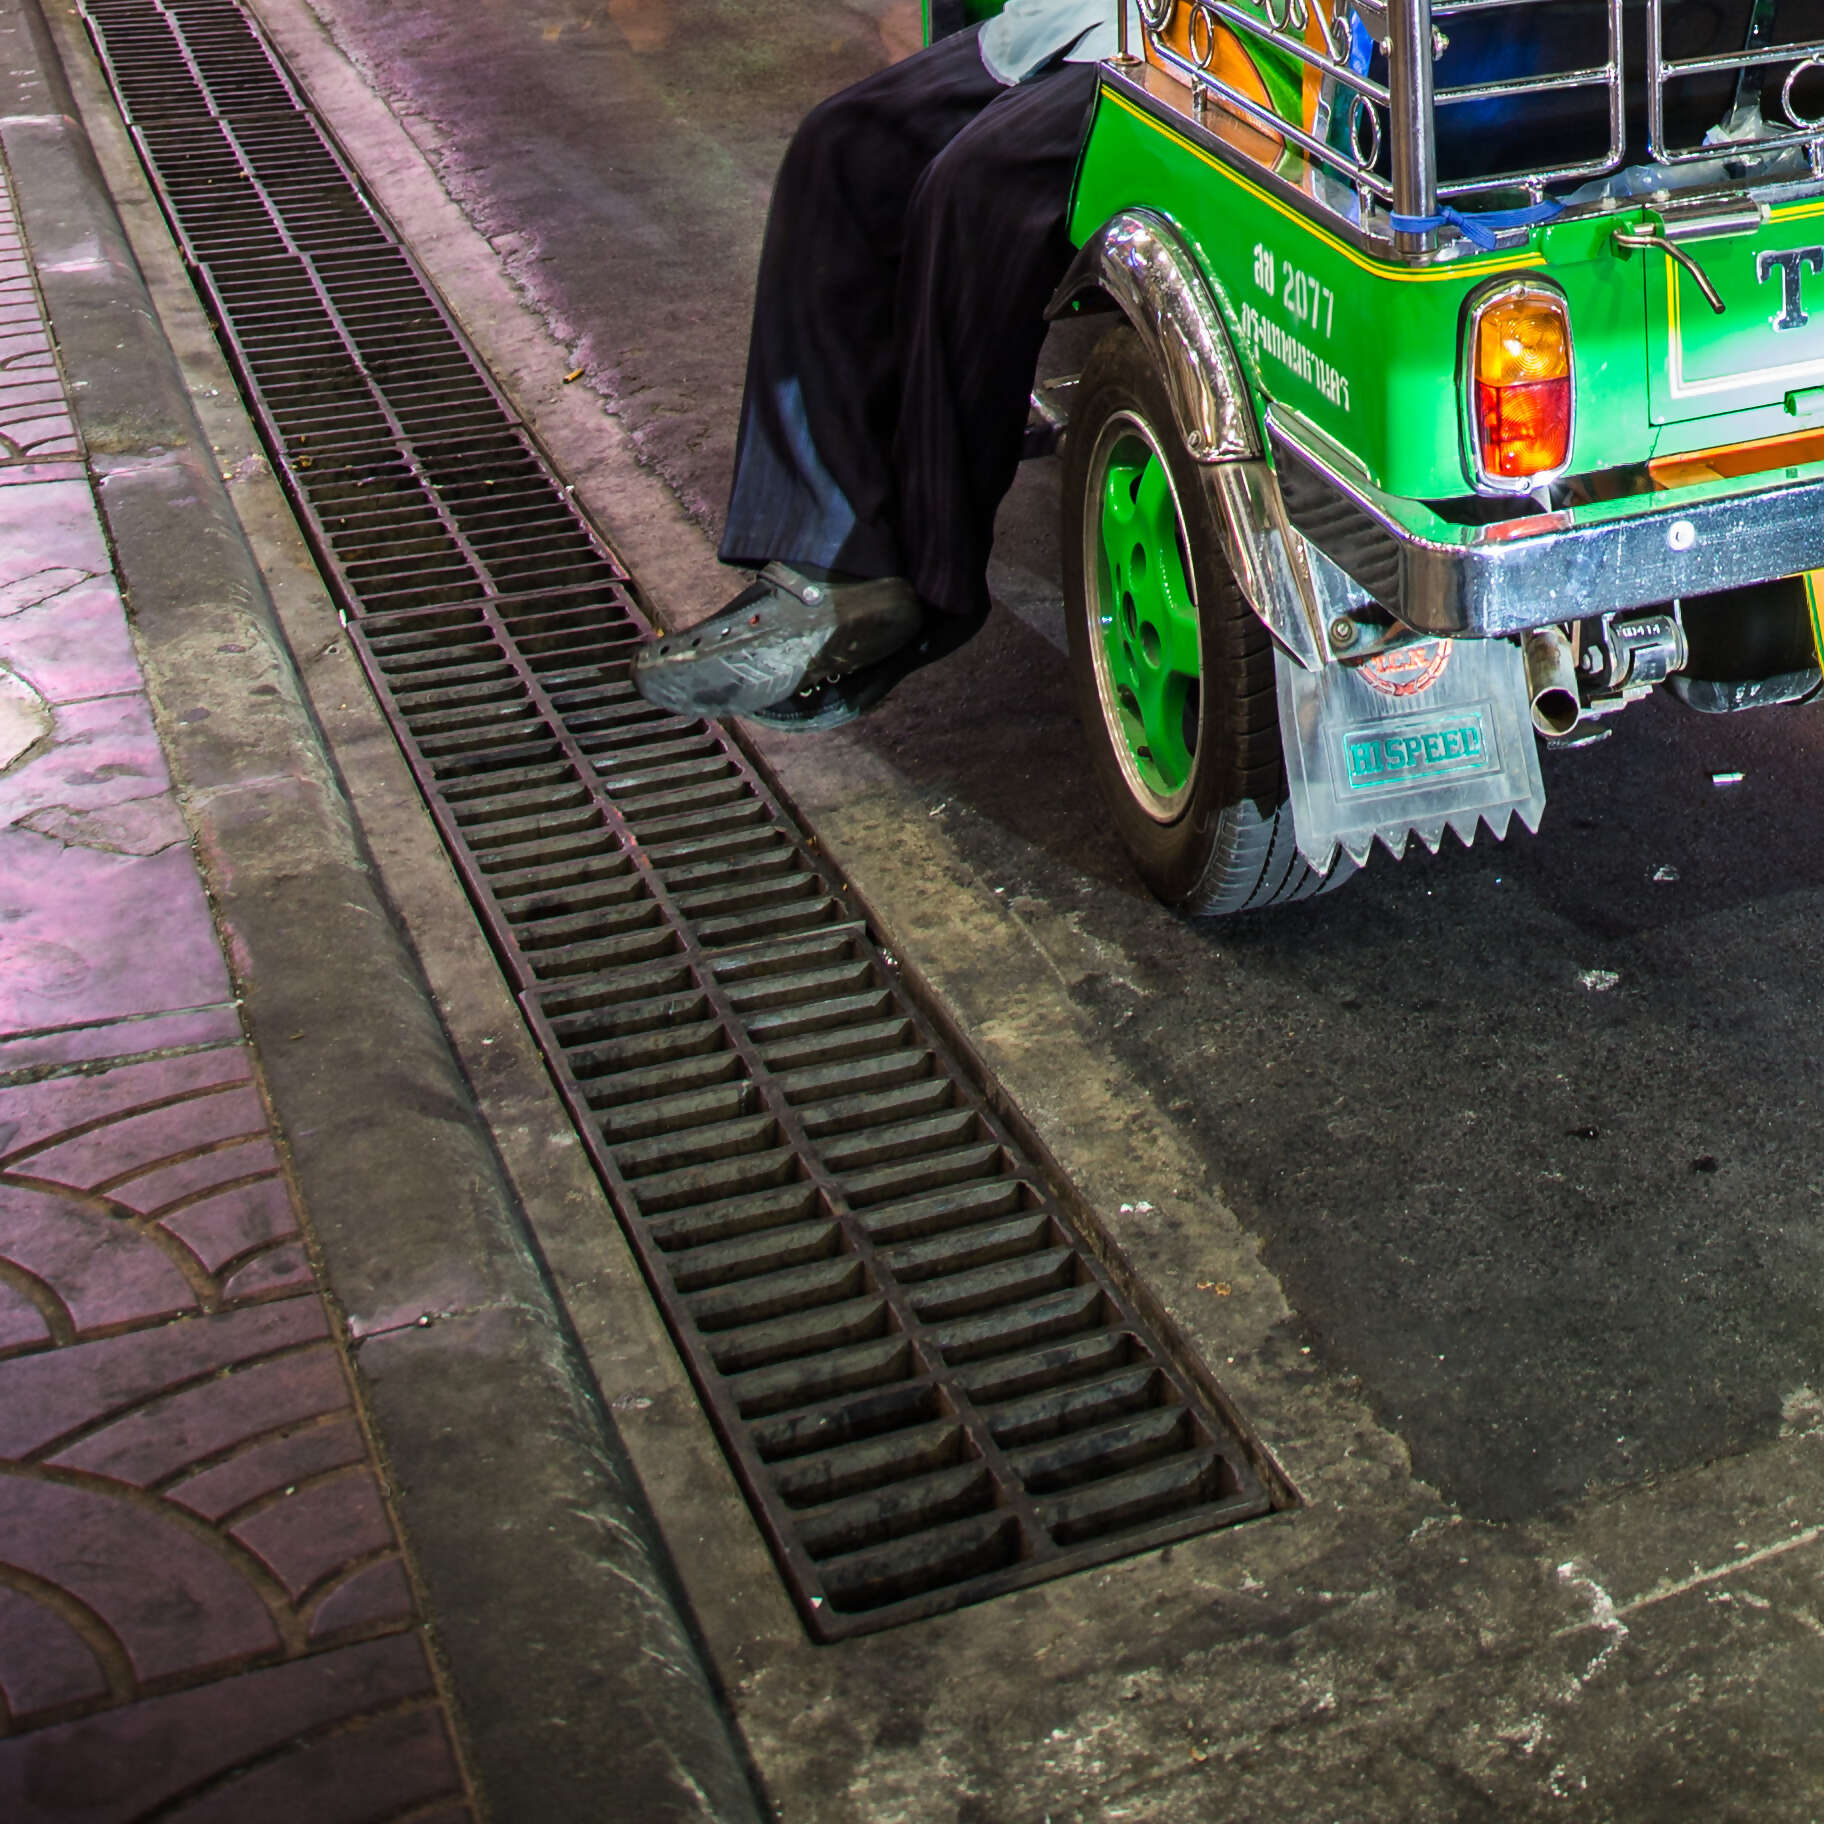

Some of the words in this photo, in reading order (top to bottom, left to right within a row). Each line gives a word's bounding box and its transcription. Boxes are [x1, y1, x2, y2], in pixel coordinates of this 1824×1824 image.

[1283, 260, 1334, 339] 2077
[1242, 302, 1350, 412] กรุงเทพมหานคร
[1349, 742, 1385, 776] HI
[1386, 726, 1480, 771] SPEED
